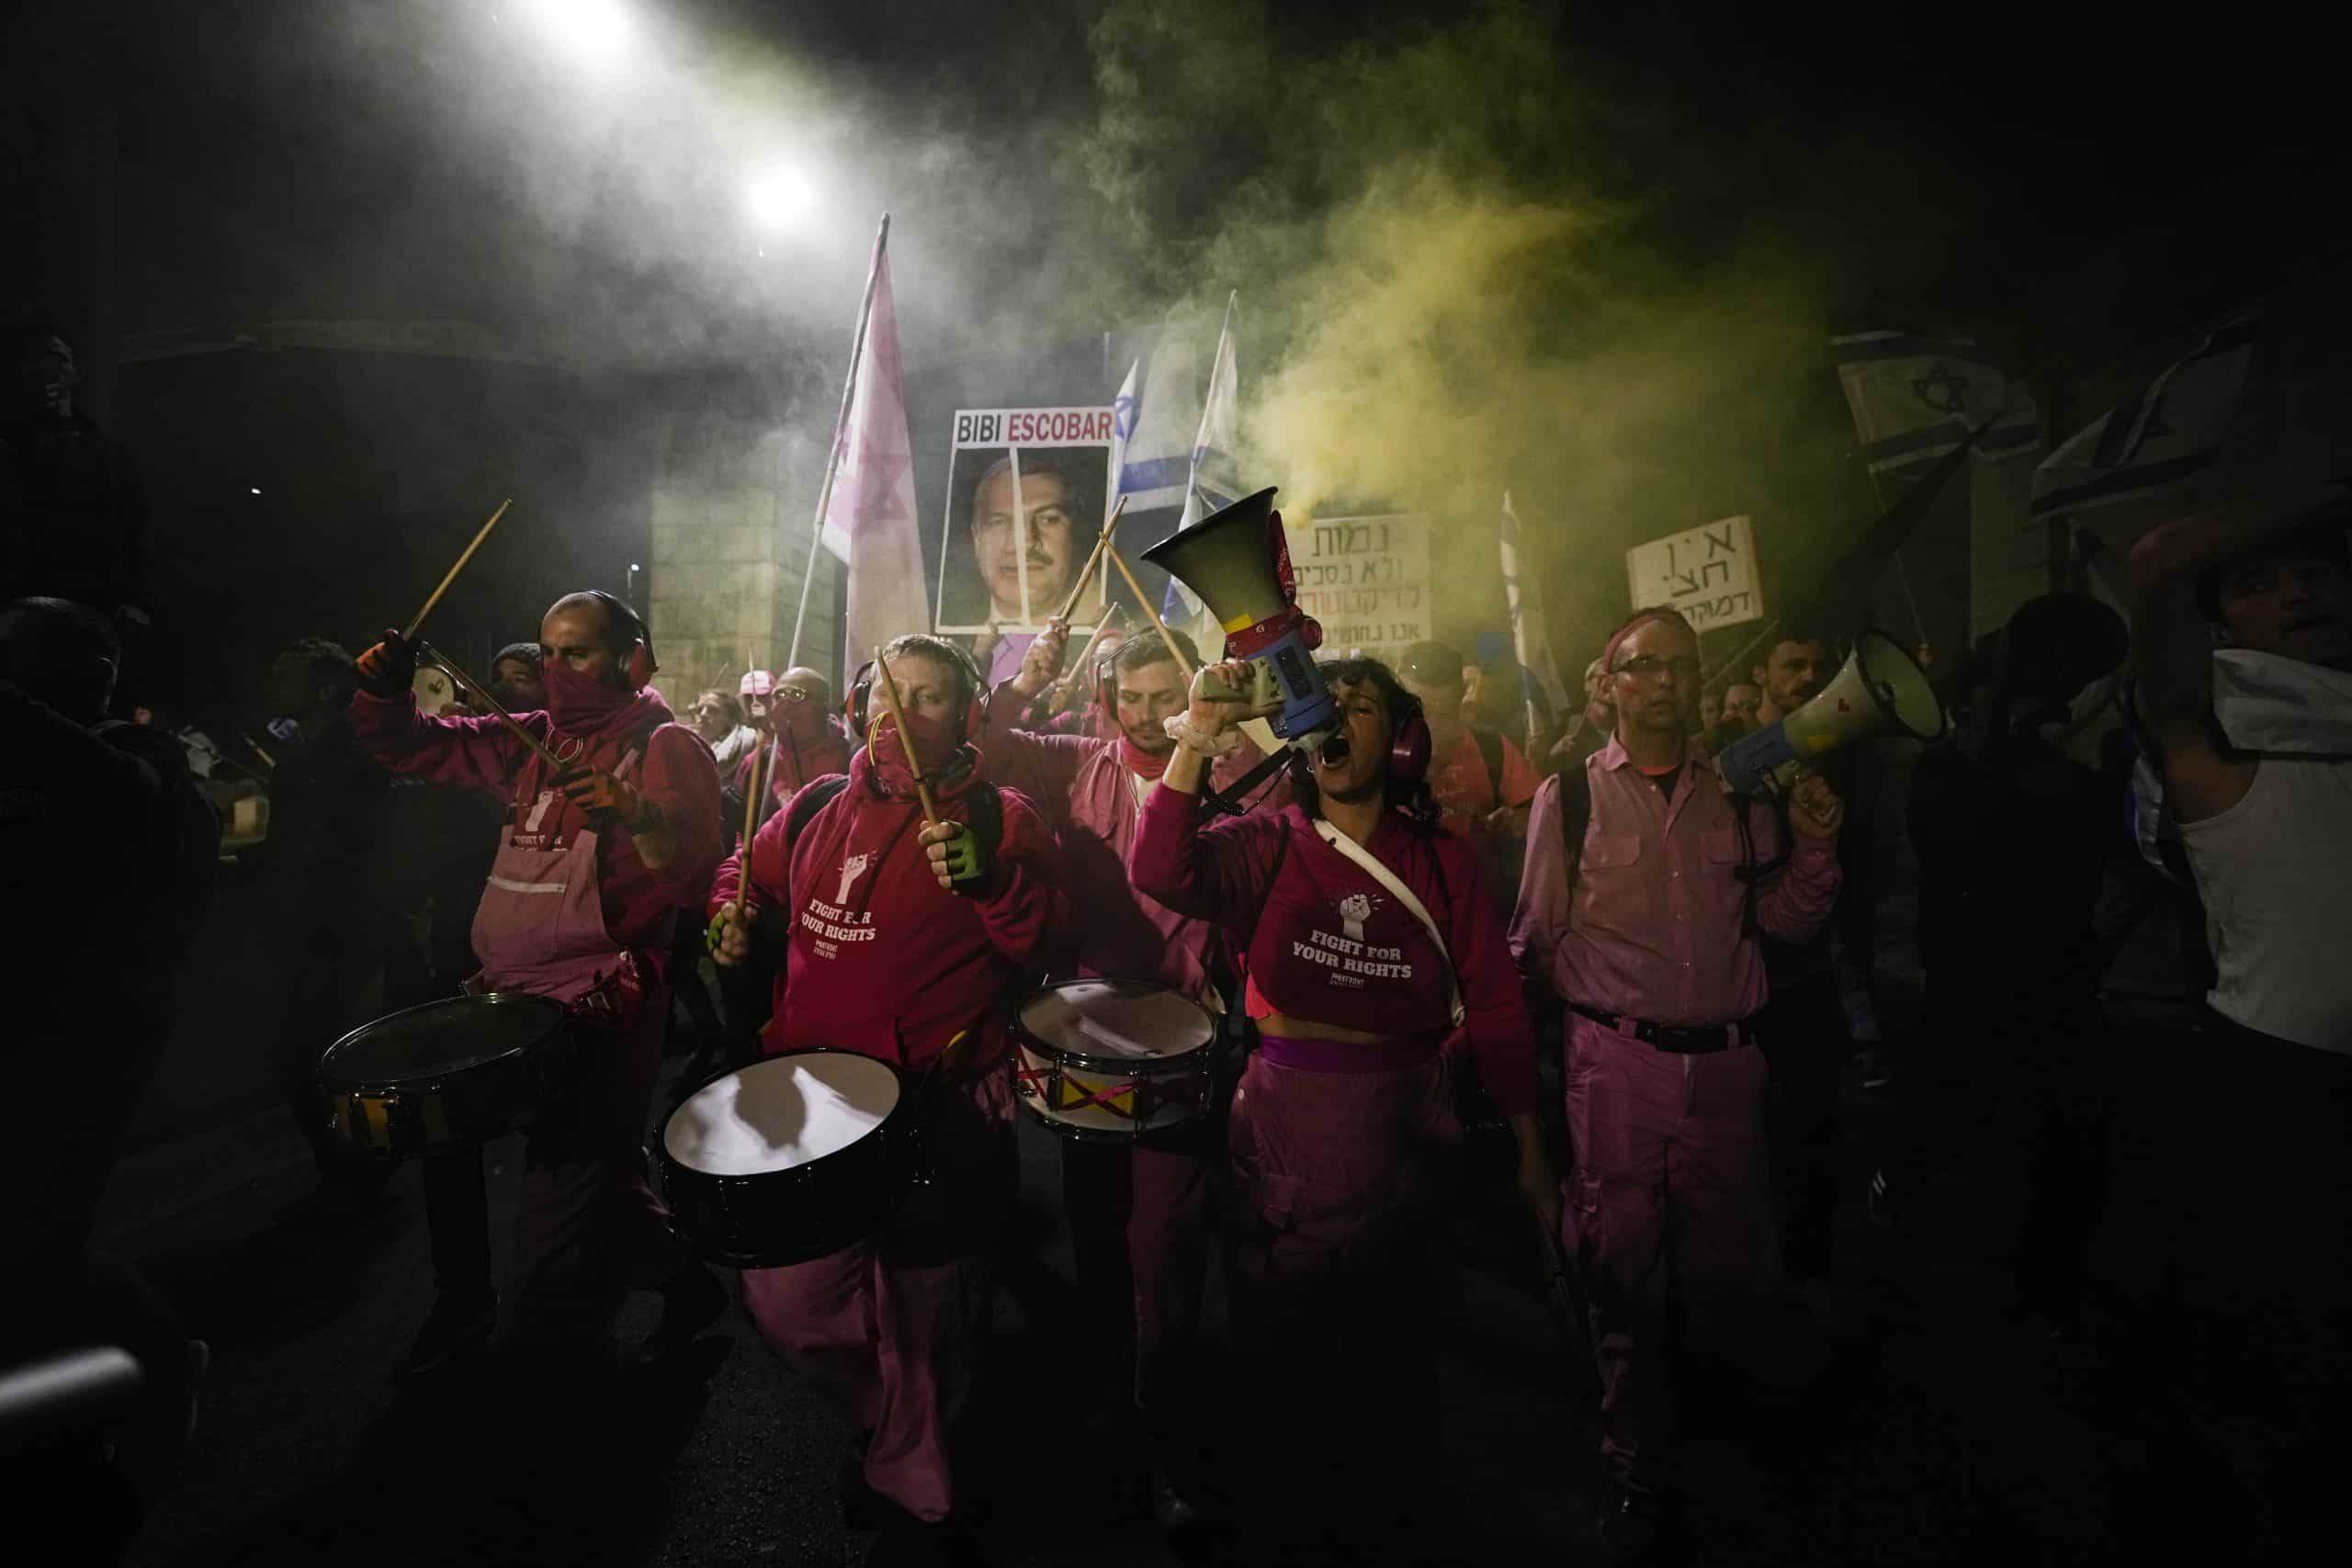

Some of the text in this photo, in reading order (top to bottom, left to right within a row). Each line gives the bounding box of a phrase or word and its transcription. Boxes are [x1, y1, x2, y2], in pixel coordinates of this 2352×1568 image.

[957, 412, 1113, 443] BIBI ESCOBAR
[1668, 524, 1736, 578] אין
[1361, 557, 1403, 583] ולא
[1663, 560, 1728, 597] חצי
[808, 898, 842, 921] FIGHT
[801, 911, 876, 942] OUR RIGHTS
[1293, 941, 1340, 967] YOUR
[1343, 957, 1412, 978] RIGHTS
[1310, 929, 1402, 962] FIGHT FOR
